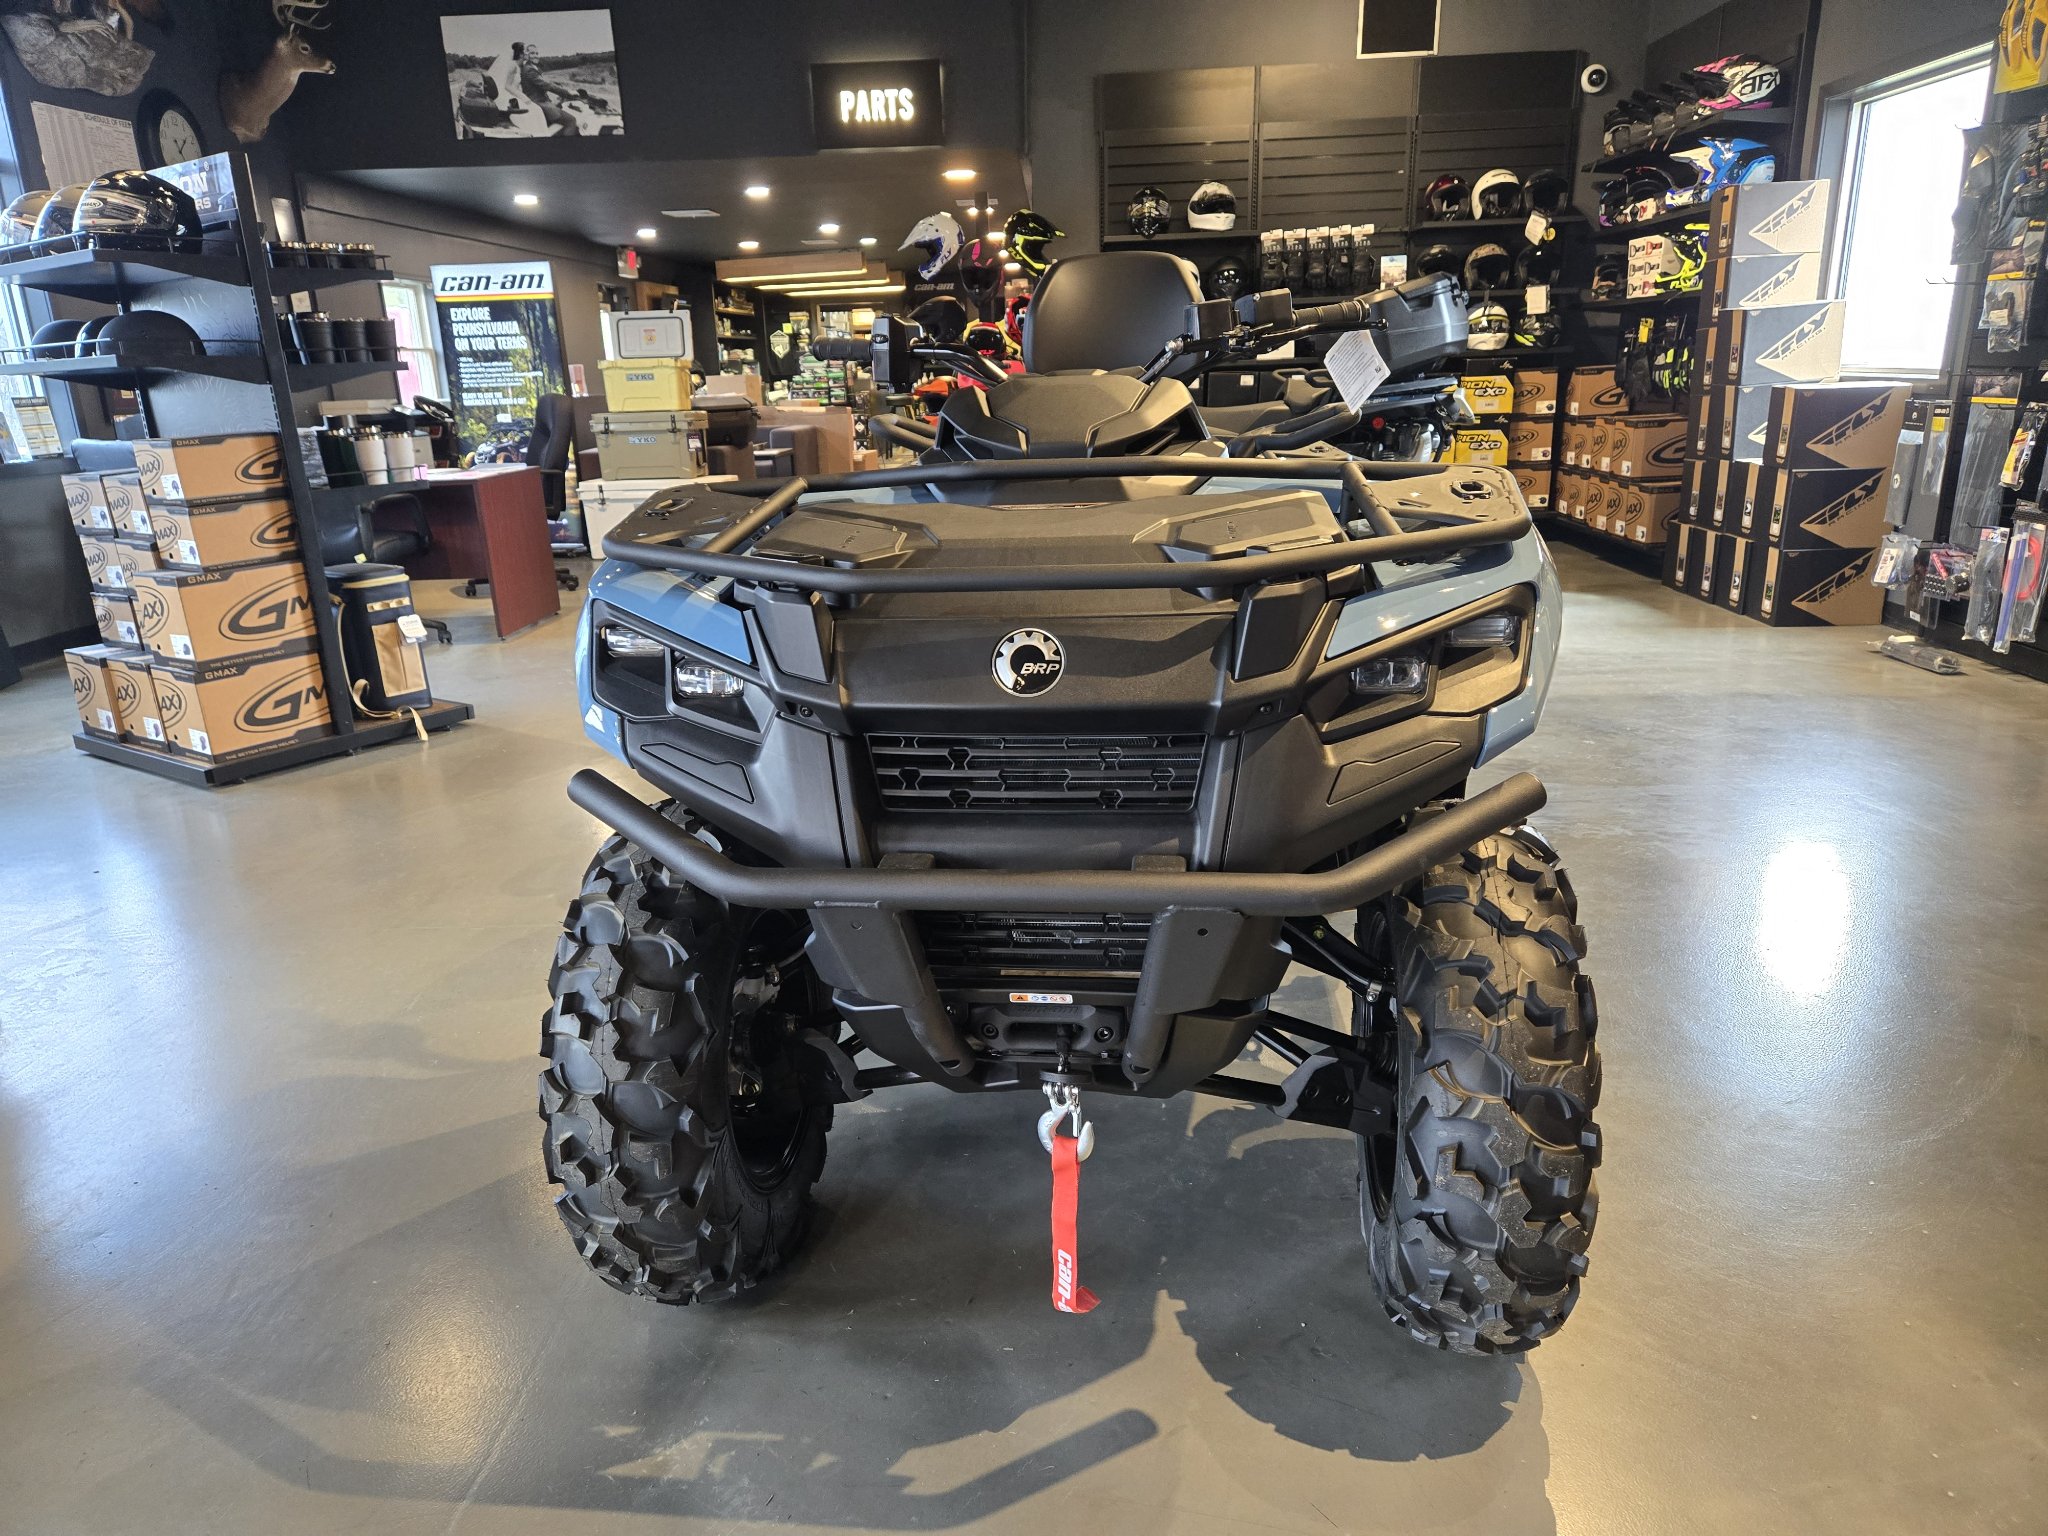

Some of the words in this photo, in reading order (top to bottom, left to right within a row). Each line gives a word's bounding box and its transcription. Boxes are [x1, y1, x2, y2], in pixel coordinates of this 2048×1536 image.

[839, 87, 915, 123] PARTS
[83, 112, 111, 125] SCHEDULE
[941, 248, 952, 265] FLY
[1007, 247, 1023, 261] FLY
[440, 273, 544, 292] can-am
[914, 282, 954, 292] can-am
[450, 306, 491, 321] EXPLORE
[452, 321, 521, 337] PENNSYLVANIA
[454, 337, 470, 351] ON
[470, 336, 497, 351] YOUR
[496, 335, 528, 350] TERMS
[1460, 379, 1496, 390] PION
[1474, 387, 1507, 397] EXO
[1456, 433, 1491, 442] PION
[1469, 440, 1502, 450] EXO
[68, 492, 88, 508] MAX
[110, 495, 128, 511] MAX
[193, 506, 216, 515] GMAX
[155, 526, 174, 540] MAX
[187, 572, 222, 584] GMAX
[228, 578, 312, 635] GM
[222, 657, 243, 667] BETTER
[263, 649, 285, 659] HELMET
[205, 667, 238, 680] GMAX
[1020, 662, 1060, 675] BRP
[117, 683, 132, 701] AX
[243, 667, 325, 727] GM
[160, 693, 178, 712] AX
[238, 749, 259, 759] BETTER
[278, 738, 299, 748] HELMET
